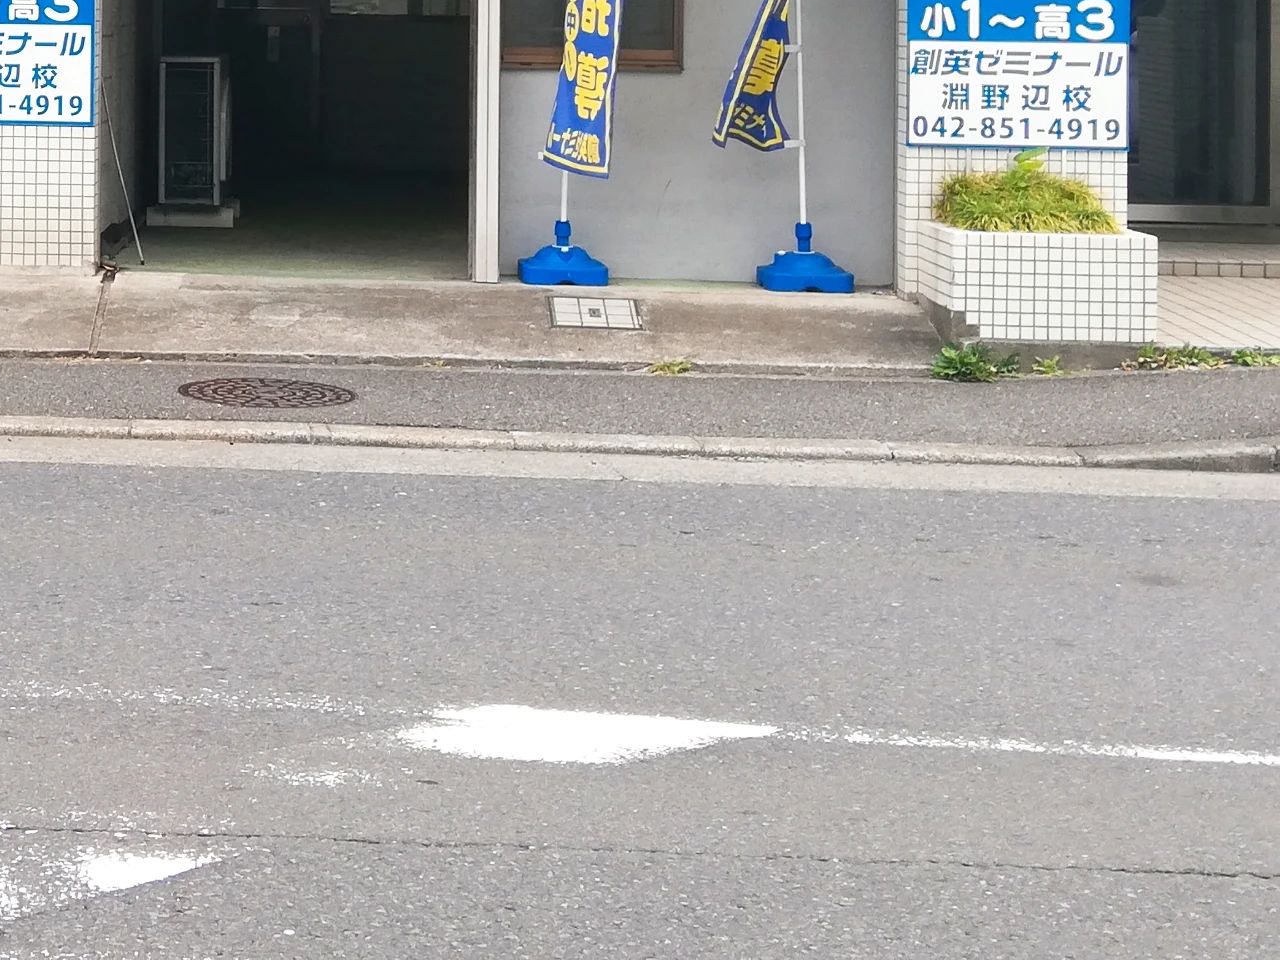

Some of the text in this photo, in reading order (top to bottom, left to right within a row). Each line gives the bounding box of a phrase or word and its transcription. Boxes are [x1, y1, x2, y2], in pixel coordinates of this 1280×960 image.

[911, 49, 1123, 76] 創英ゼミナール
[941, 83, 1093, 112] 淵野辺校
[912, 115, 1120, 140] 042-851-4919
